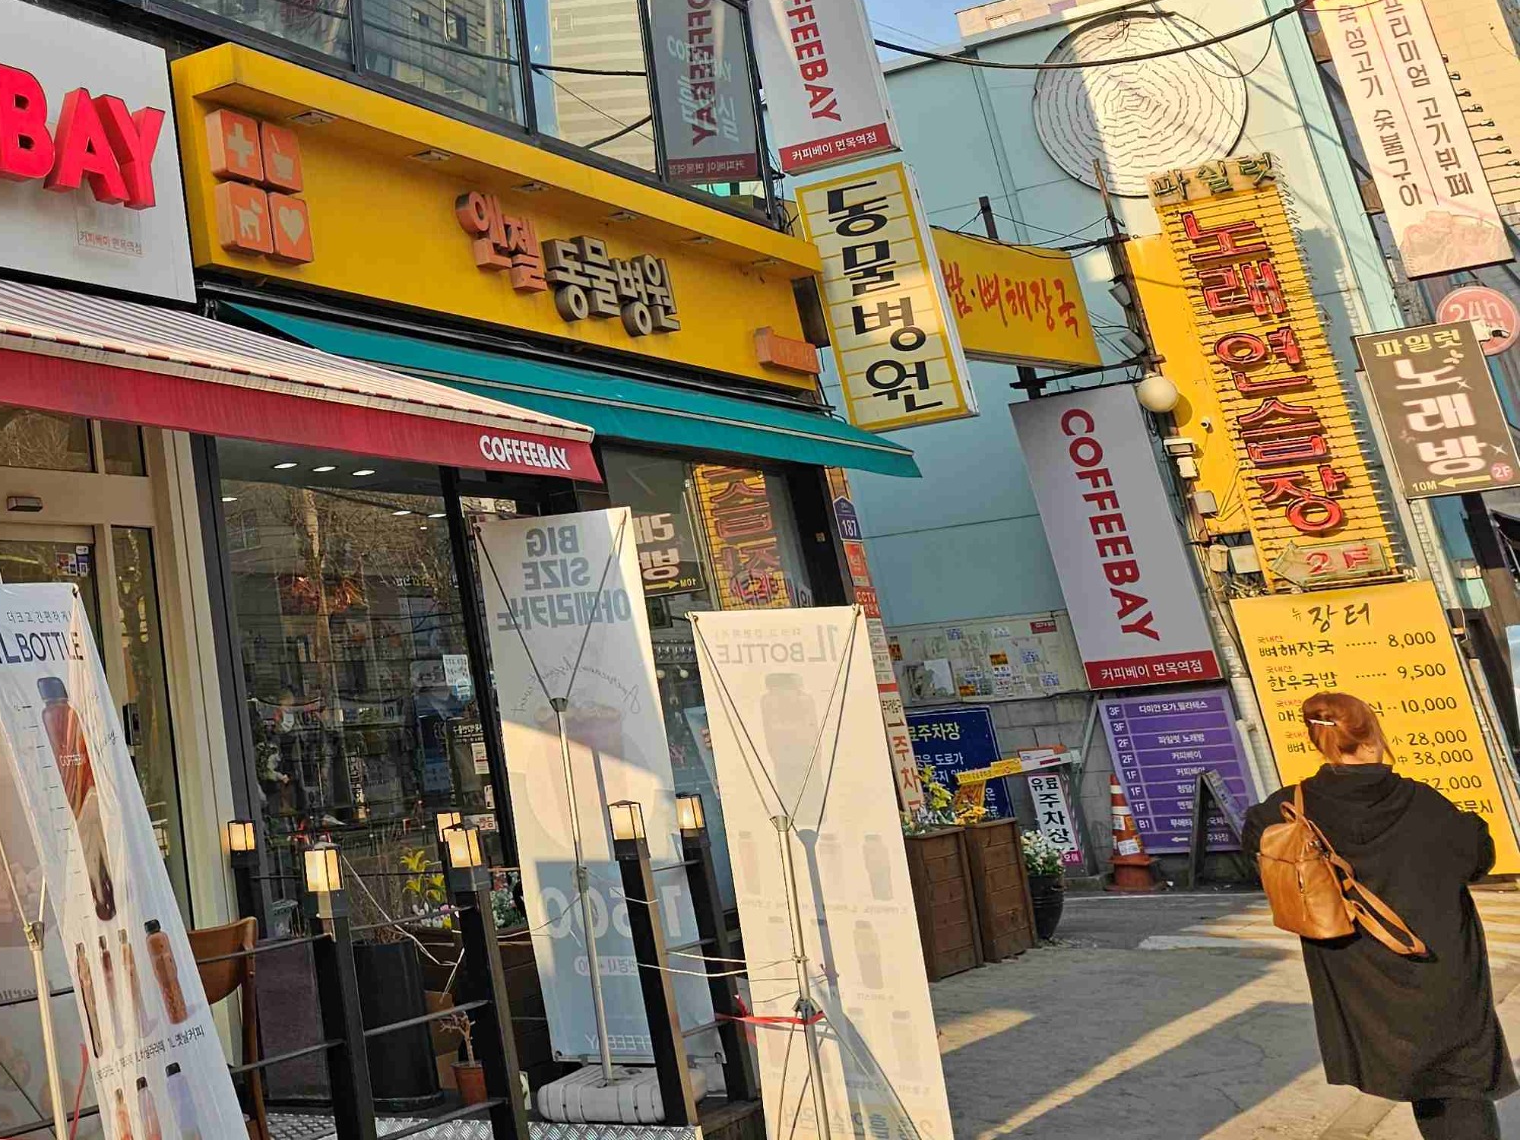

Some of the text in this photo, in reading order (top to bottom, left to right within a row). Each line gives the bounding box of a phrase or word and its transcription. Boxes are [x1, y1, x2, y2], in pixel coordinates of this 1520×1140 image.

[792, 131, 878, 161] 커피베이 면목역점
[1417, 95, 1475, 198] 고기뷔페
[455, 191, 681, 337] 엔젤 동물병원
[827, 181, 943, 412] 동물병원
[1374, 329, 1464, 358] 파일럿
[1182, 210, 1348, 535] 노래연습장
[1393, 359, 1488, 475] 노래방
[480, 434, 572, 471] COFFEEBAY
[1412, 466, 1511, 492] 10M 2F
[841, 519, 858, 538] 187
[1060, 408, 1161, 642] COFFEEBAY
[1306, 546, 1369, 577] 2F
[15, 632, 84, 661] BOTTLE
[1259, 631, 1436, 657] 뼈해장국 8,000
[1100, 661, 1203, 681] 커피베이 면목역점
[1267, 663, 1446, 692] 한우국밥 9,500
[1109, 706, 1120, 716] 3F
[1401, 697, 1457, 715] 10,000
[1113, 722, 1125, 733] 3F
[1407, 729, 1467, 747] 28,000
[1117, 739, 1129, 748] 2F
[1122, 754, 1133, 764] 2F
[1413, 749, 1474, 767] 38,000
[1031, 777, 1059, 792] 유료
[1126, 770, 1137, 780] 1F
[1130, 786, 1141, 796] 1F
[1039, 793, 1072, 844] 주차장
[1134, 802, 1146, 812] 1F
[1139, 819, 1150, 829] B1
